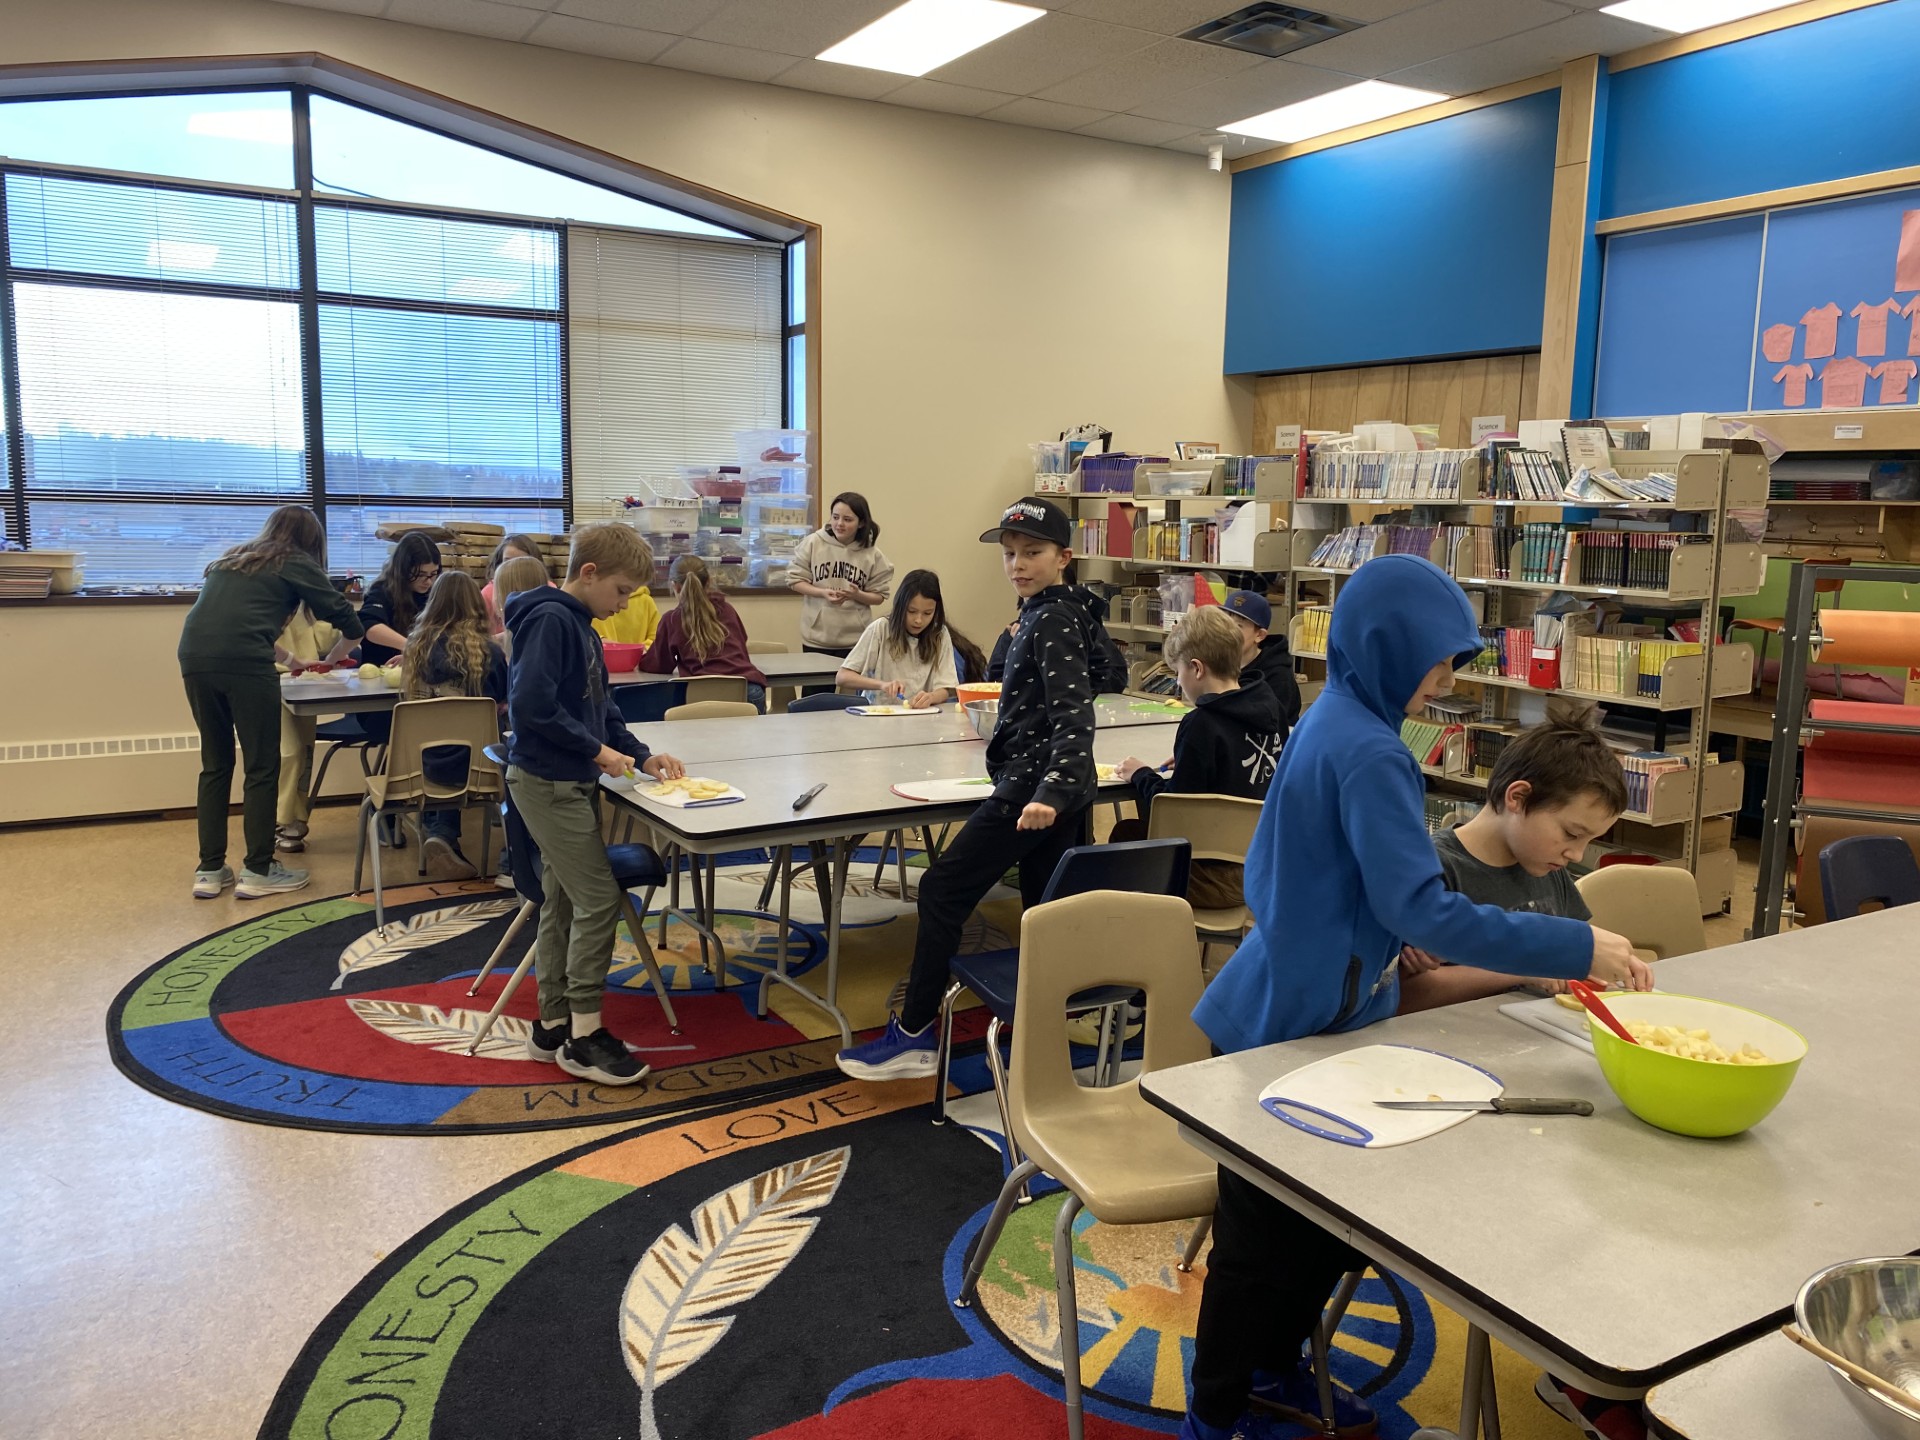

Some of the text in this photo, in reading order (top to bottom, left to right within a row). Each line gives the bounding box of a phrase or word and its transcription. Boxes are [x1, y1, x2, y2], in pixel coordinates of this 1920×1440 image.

[814, 561, 831, 582] LOS
[145, 910, 319, 1008] HONESTY
[165, 1046, 360, 1111] TRUTH
[523, 1050, 823, 1111] WISDOM
[681, 1090, 878, 1154] LOVE
[324, 1209, 542, 1440] ONESTY
